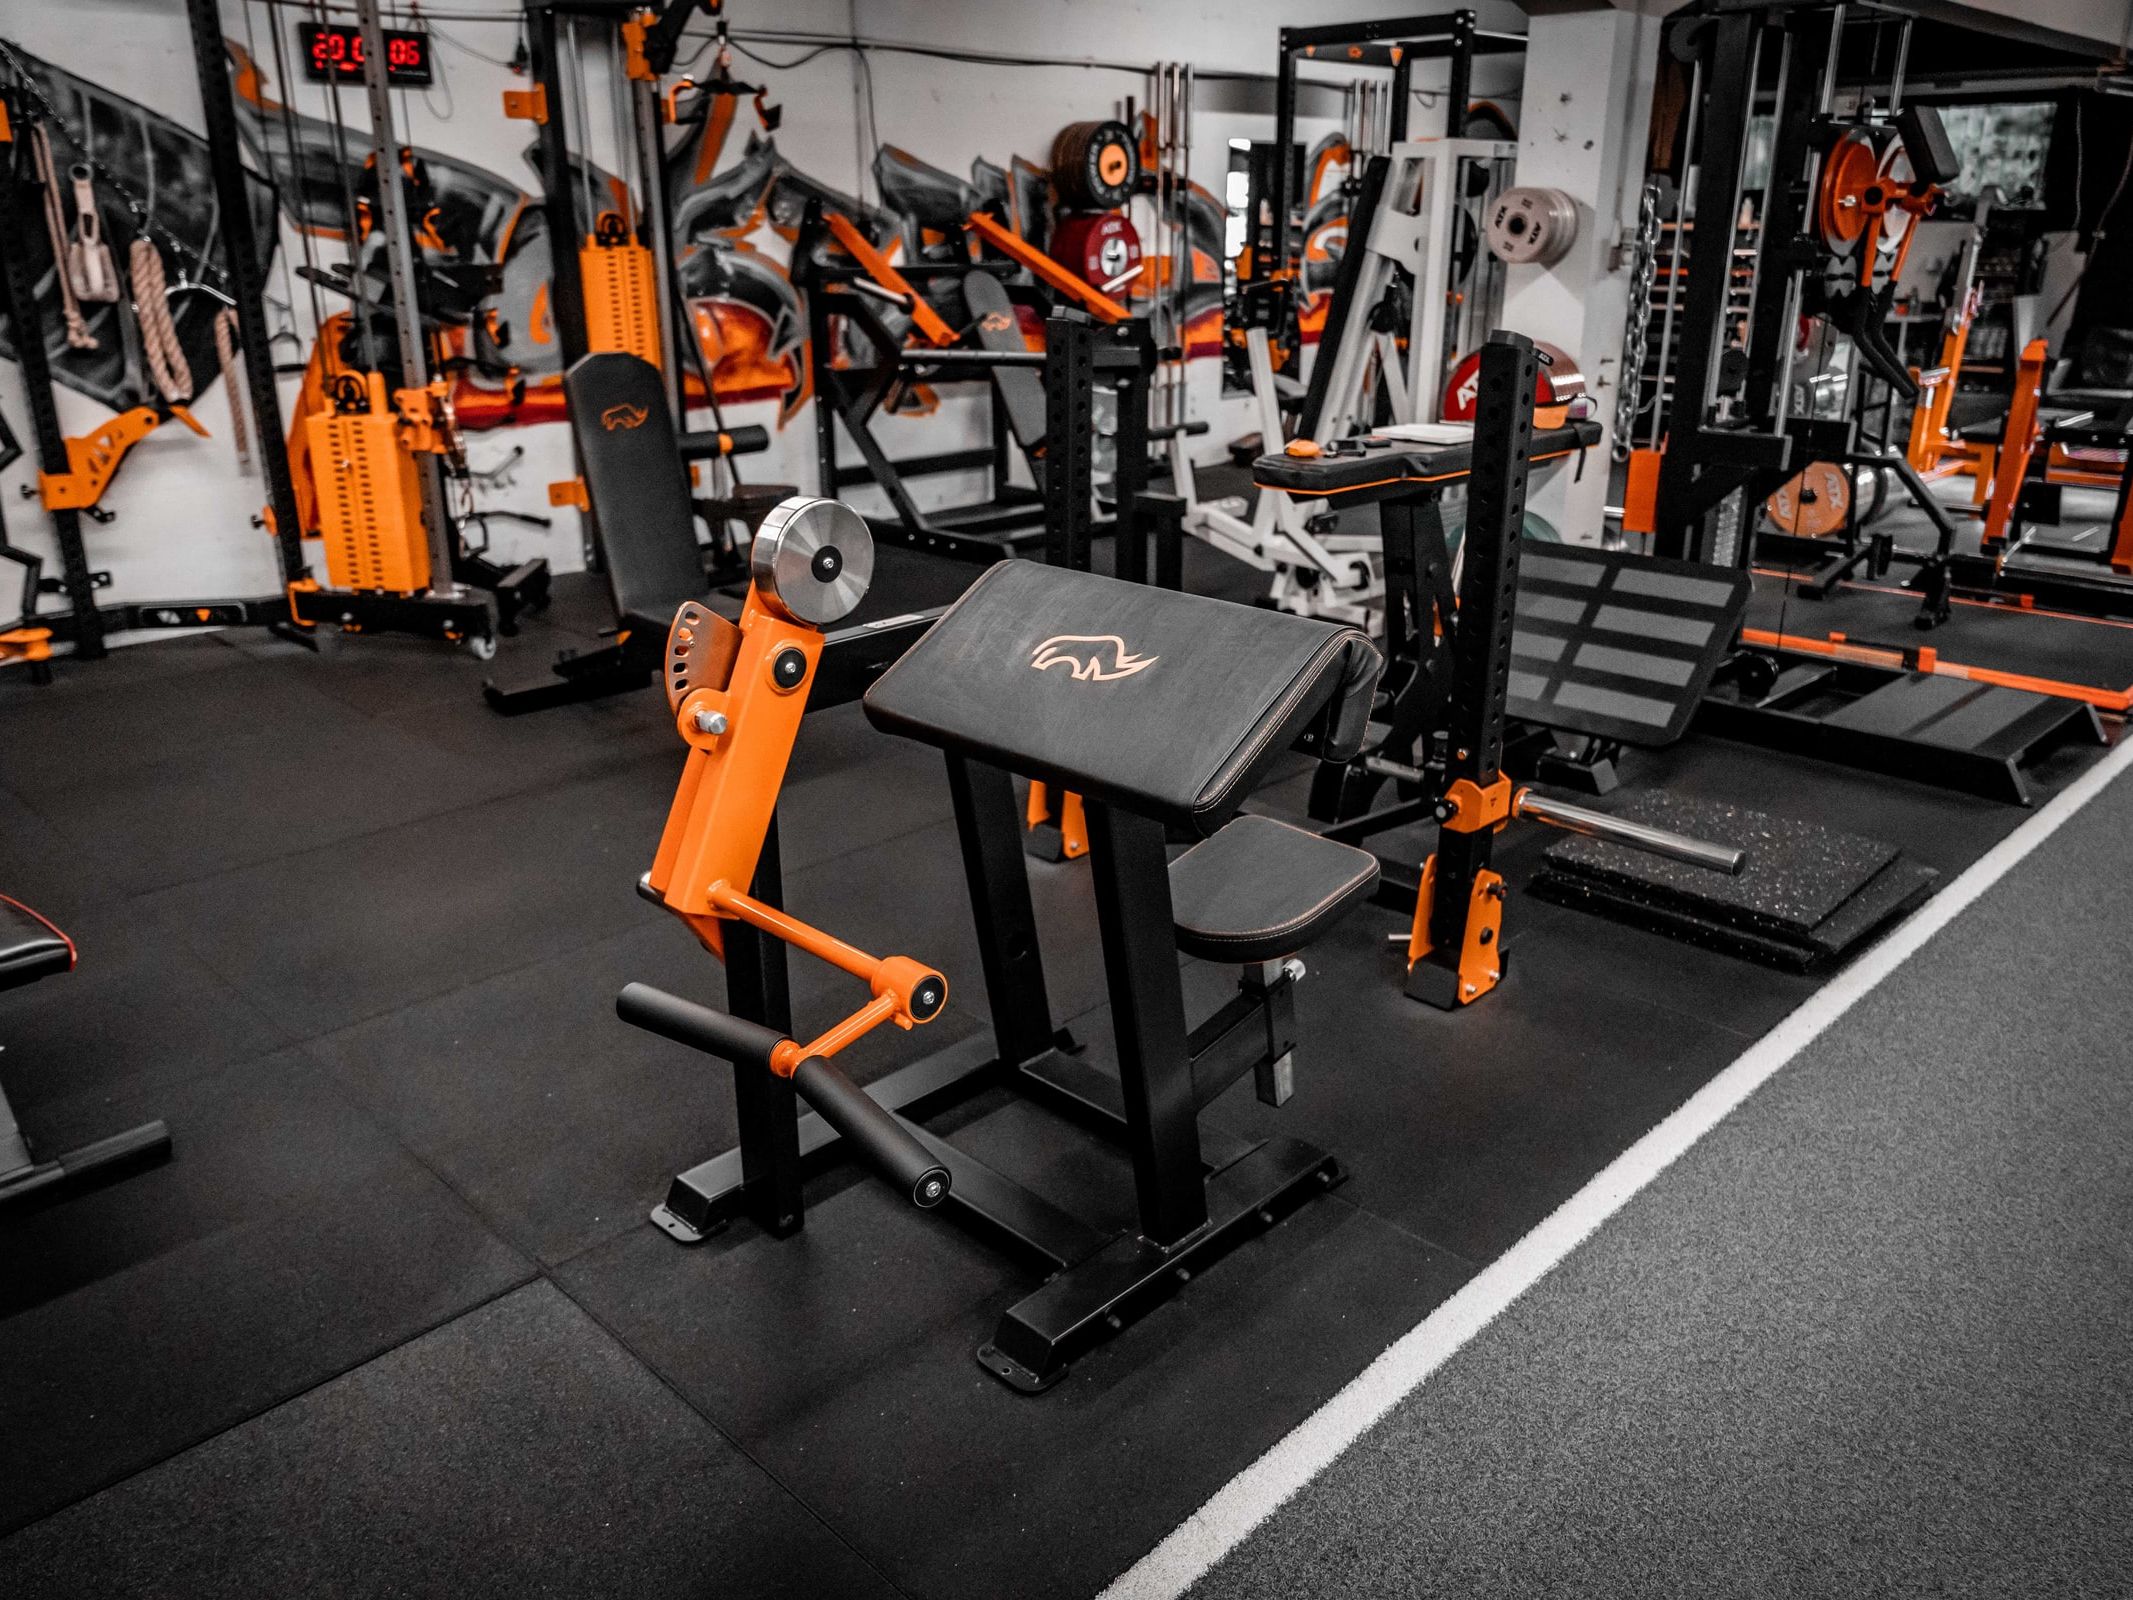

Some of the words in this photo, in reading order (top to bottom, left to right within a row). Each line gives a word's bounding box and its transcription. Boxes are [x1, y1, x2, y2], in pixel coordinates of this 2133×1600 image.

[388, 38, 420, 65] 06
[1494, 205, 1508, 229] ATX
[1527, 221, 1541, 245] ATX
[1456, 368, 1479, 411] AT
